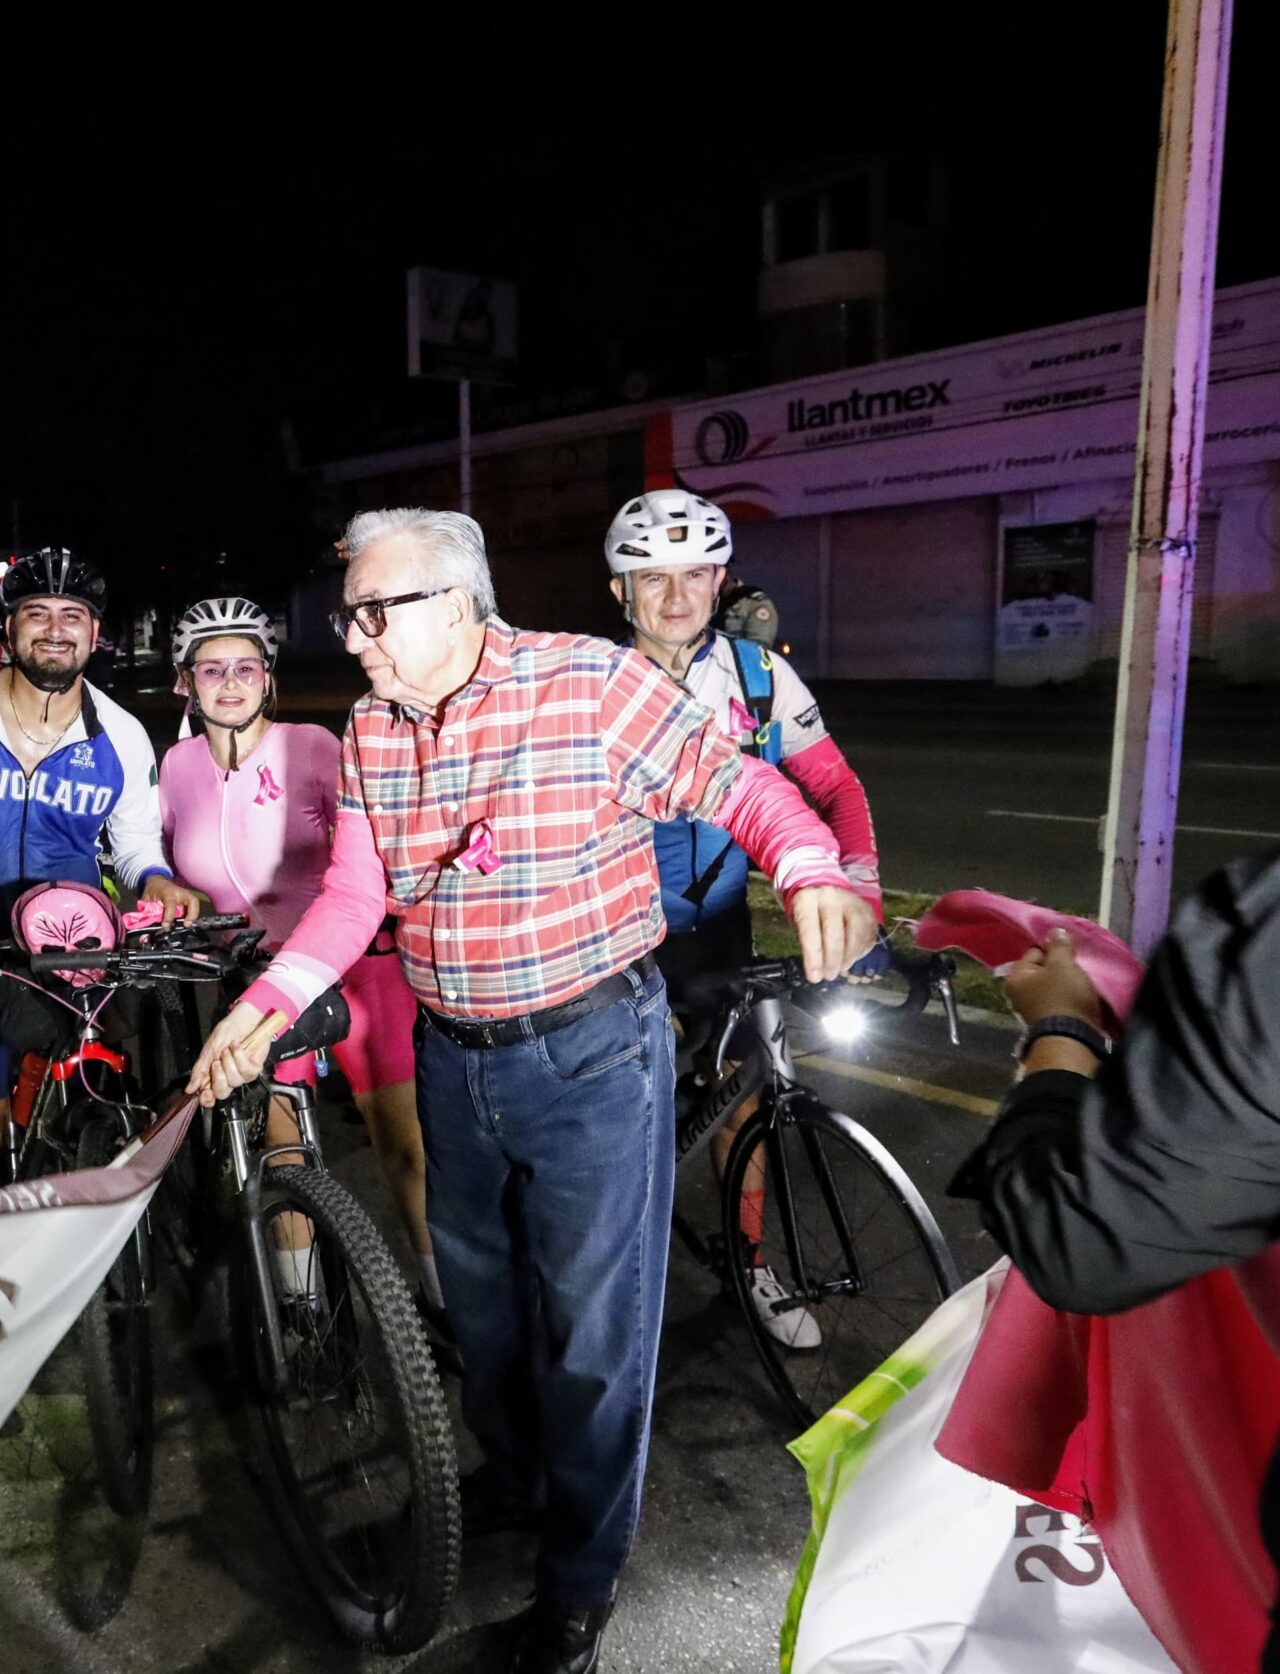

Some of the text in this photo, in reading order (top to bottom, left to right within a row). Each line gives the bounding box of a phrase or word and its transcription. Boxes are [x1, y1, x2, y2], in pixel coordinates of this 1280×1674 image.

[1030, 343, 1122, 369] MICHELIN
[788, 379, 952, 432] llantmex
[805, 428, 855, 448] LLANTAS
[870, 415, 933, 436] SERVICIOS
